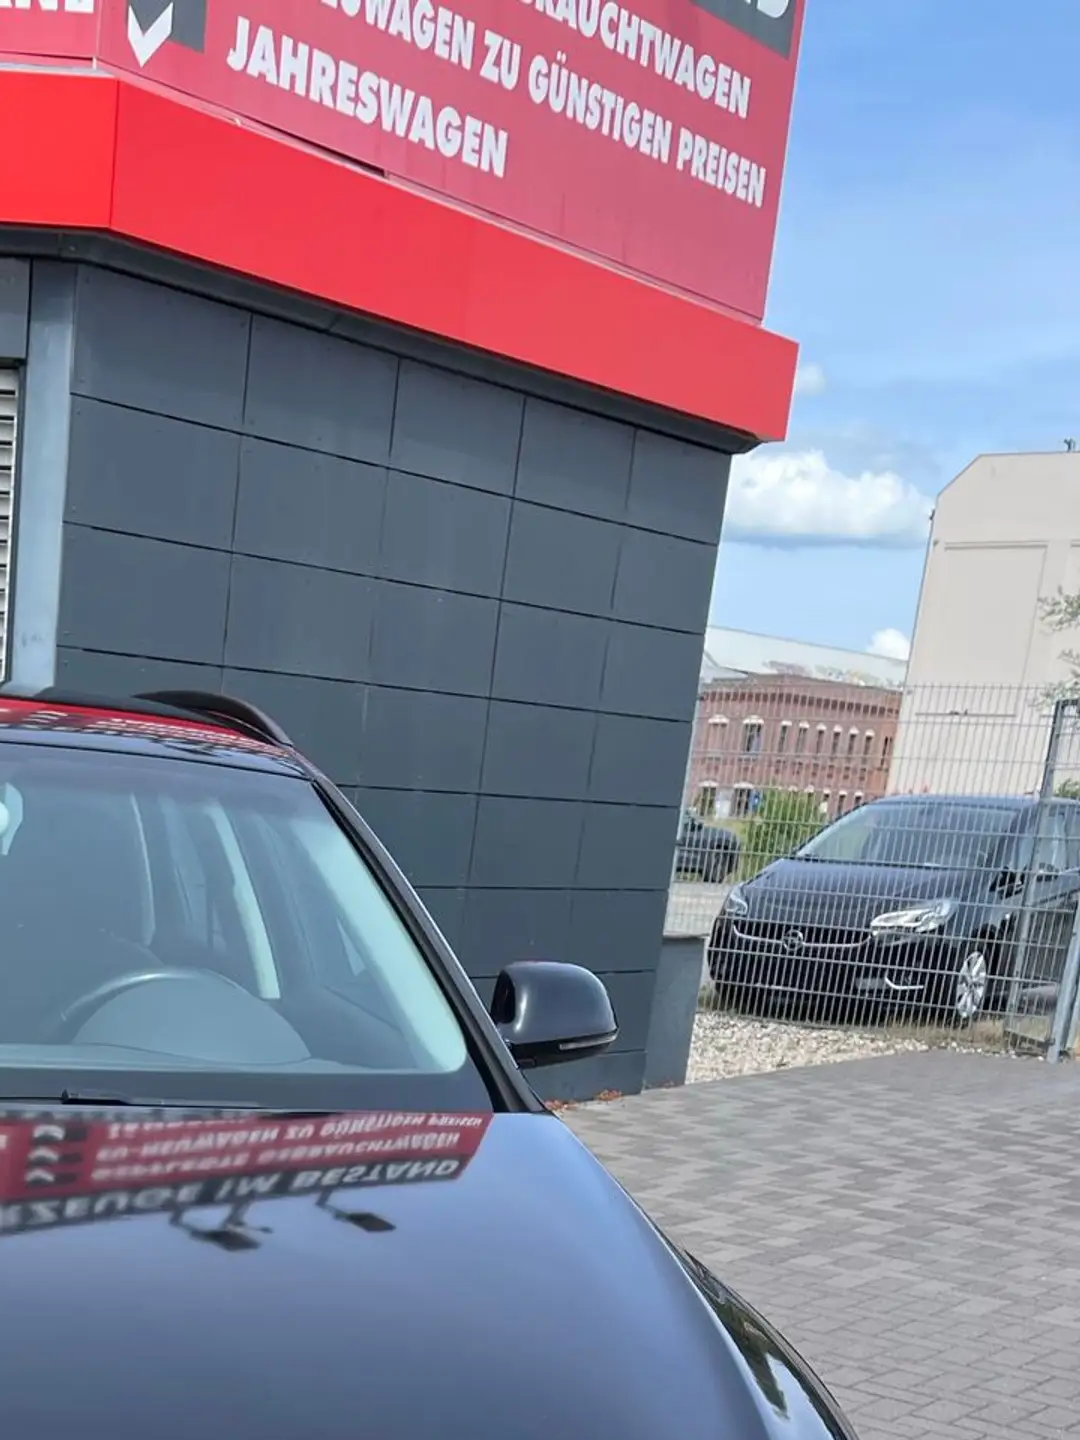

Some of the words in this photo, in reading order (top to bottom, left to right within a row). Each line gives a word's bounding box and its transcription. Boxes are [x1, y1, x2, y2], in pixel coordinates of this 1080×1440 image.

[226, 16, 508, 178] JAHRESWAGEN
[480, 29, 521, 91] ZU
[528, 51, 672, 164] GÜNSTIGEN
[677, 128, 766, 208] PREISEN
